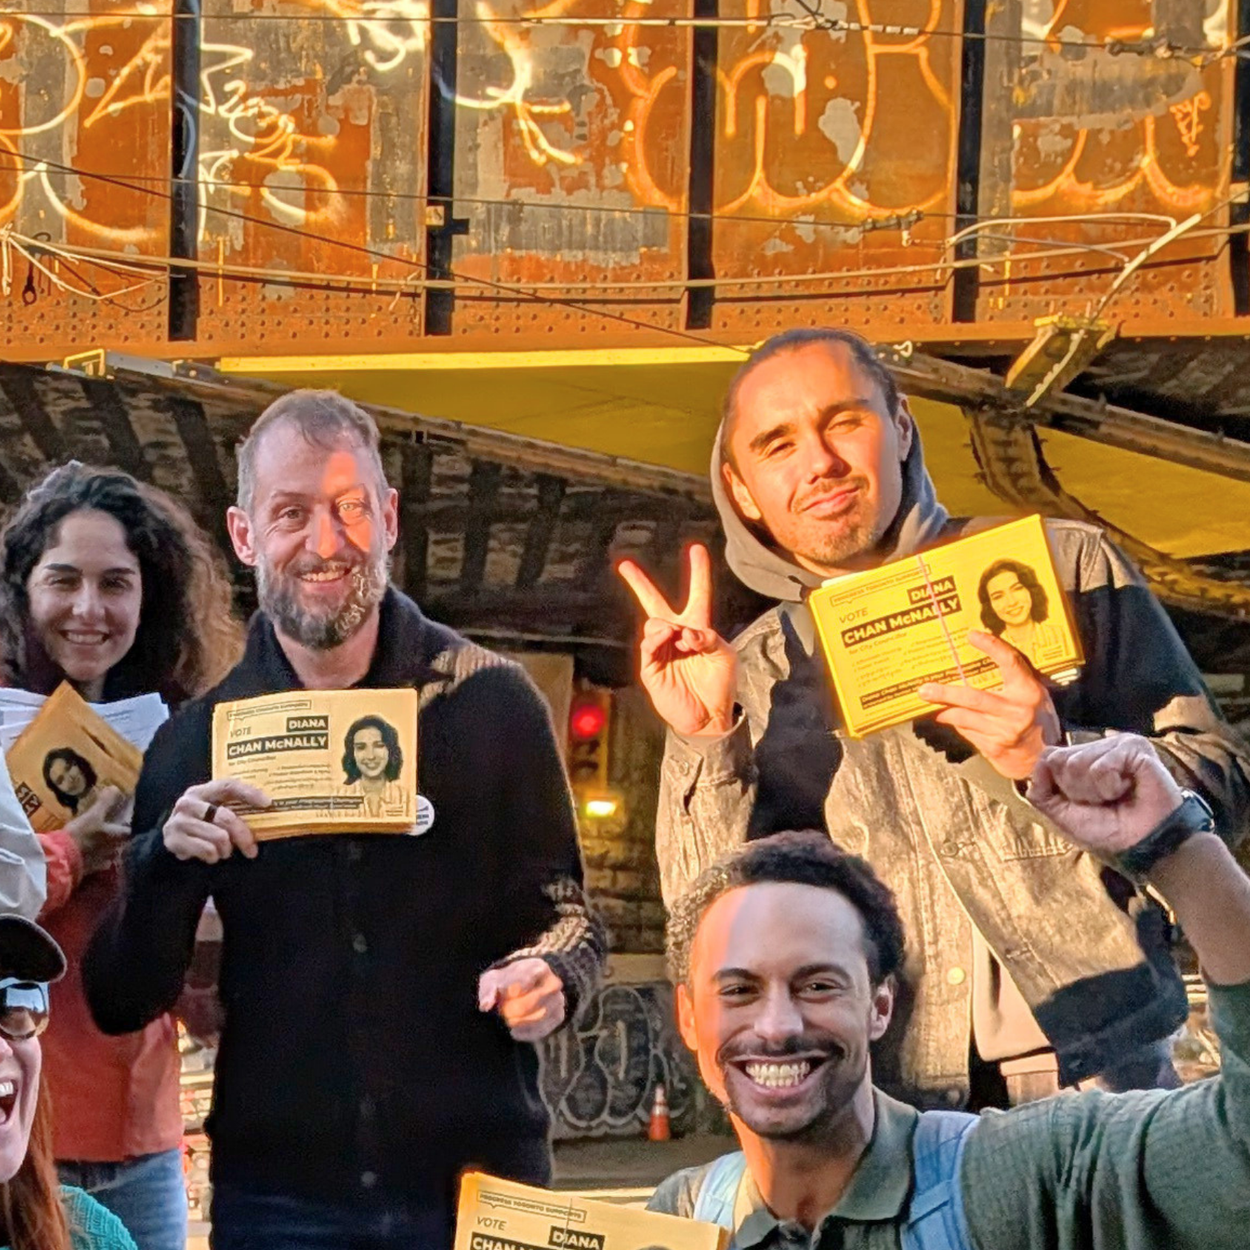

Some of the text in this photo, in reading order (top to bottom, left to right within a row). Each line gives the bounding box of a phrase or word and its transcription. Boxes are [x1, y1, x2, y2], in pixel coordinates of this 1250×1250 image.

[839, 607, 868, 624] VOTE
[844, 620, 887, 644] CHAN
[288, 718, 326, 729] DIANA
[229, 736, 327, 756] CHAN McNALLY
[477, 1216, 507, 1231] VOTE
[552, 1230, 600, 1250] DIANA
